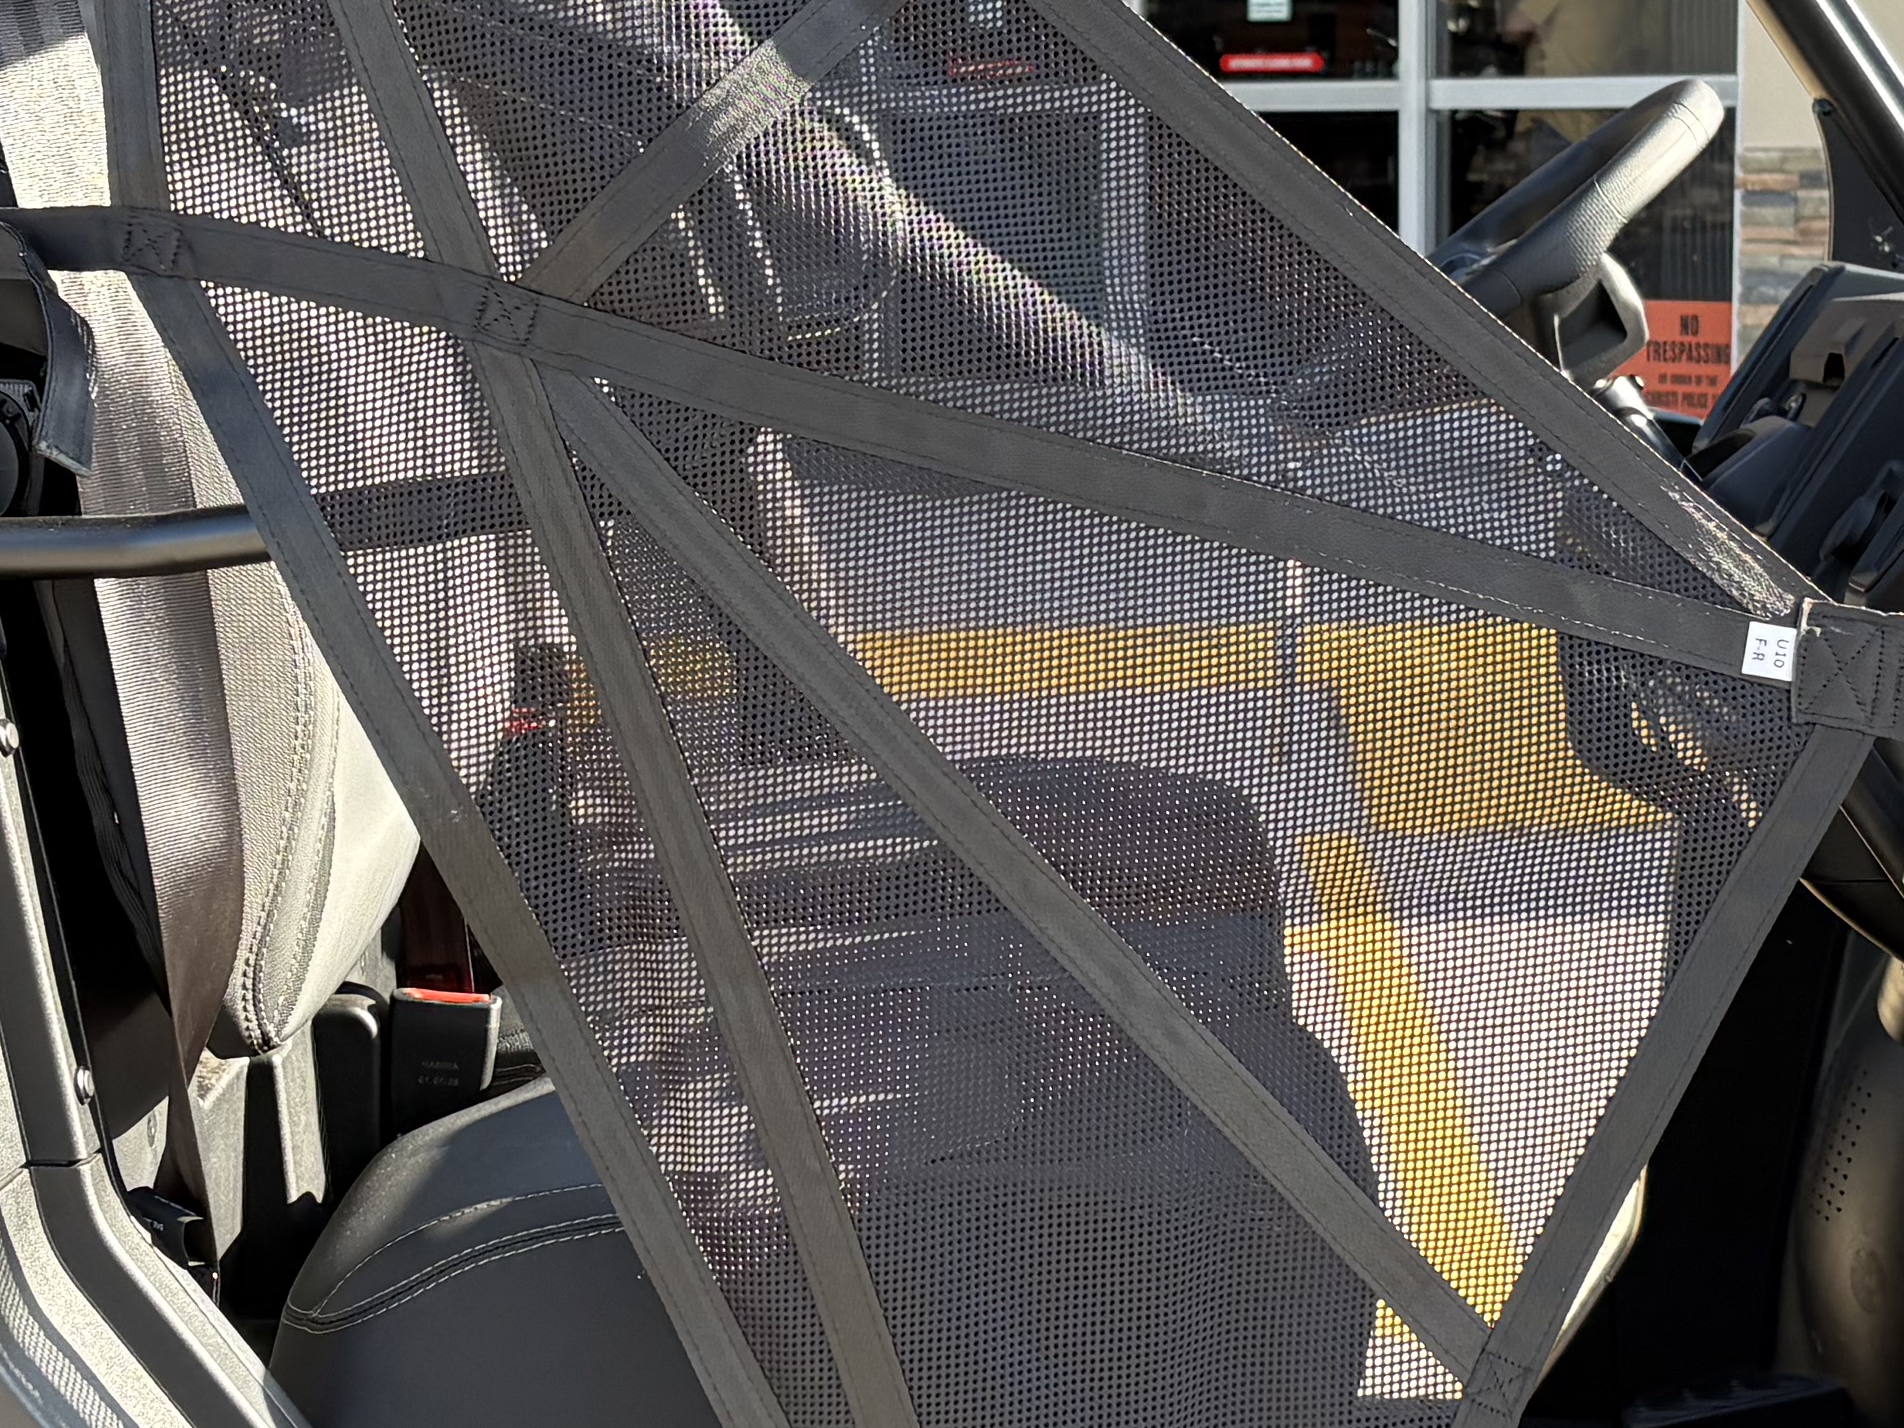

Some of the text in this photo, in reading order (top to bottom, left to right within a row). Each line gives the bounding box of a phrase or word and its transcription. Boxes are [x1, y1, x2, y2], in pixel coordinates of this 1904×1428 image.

[1679, 315, 1700, 336] NO
[1646, 340, 1731, 365] TRESPASSING
[1751, 637, 1767, 661] F-R
[1773, 639, 1789, 668] U10
